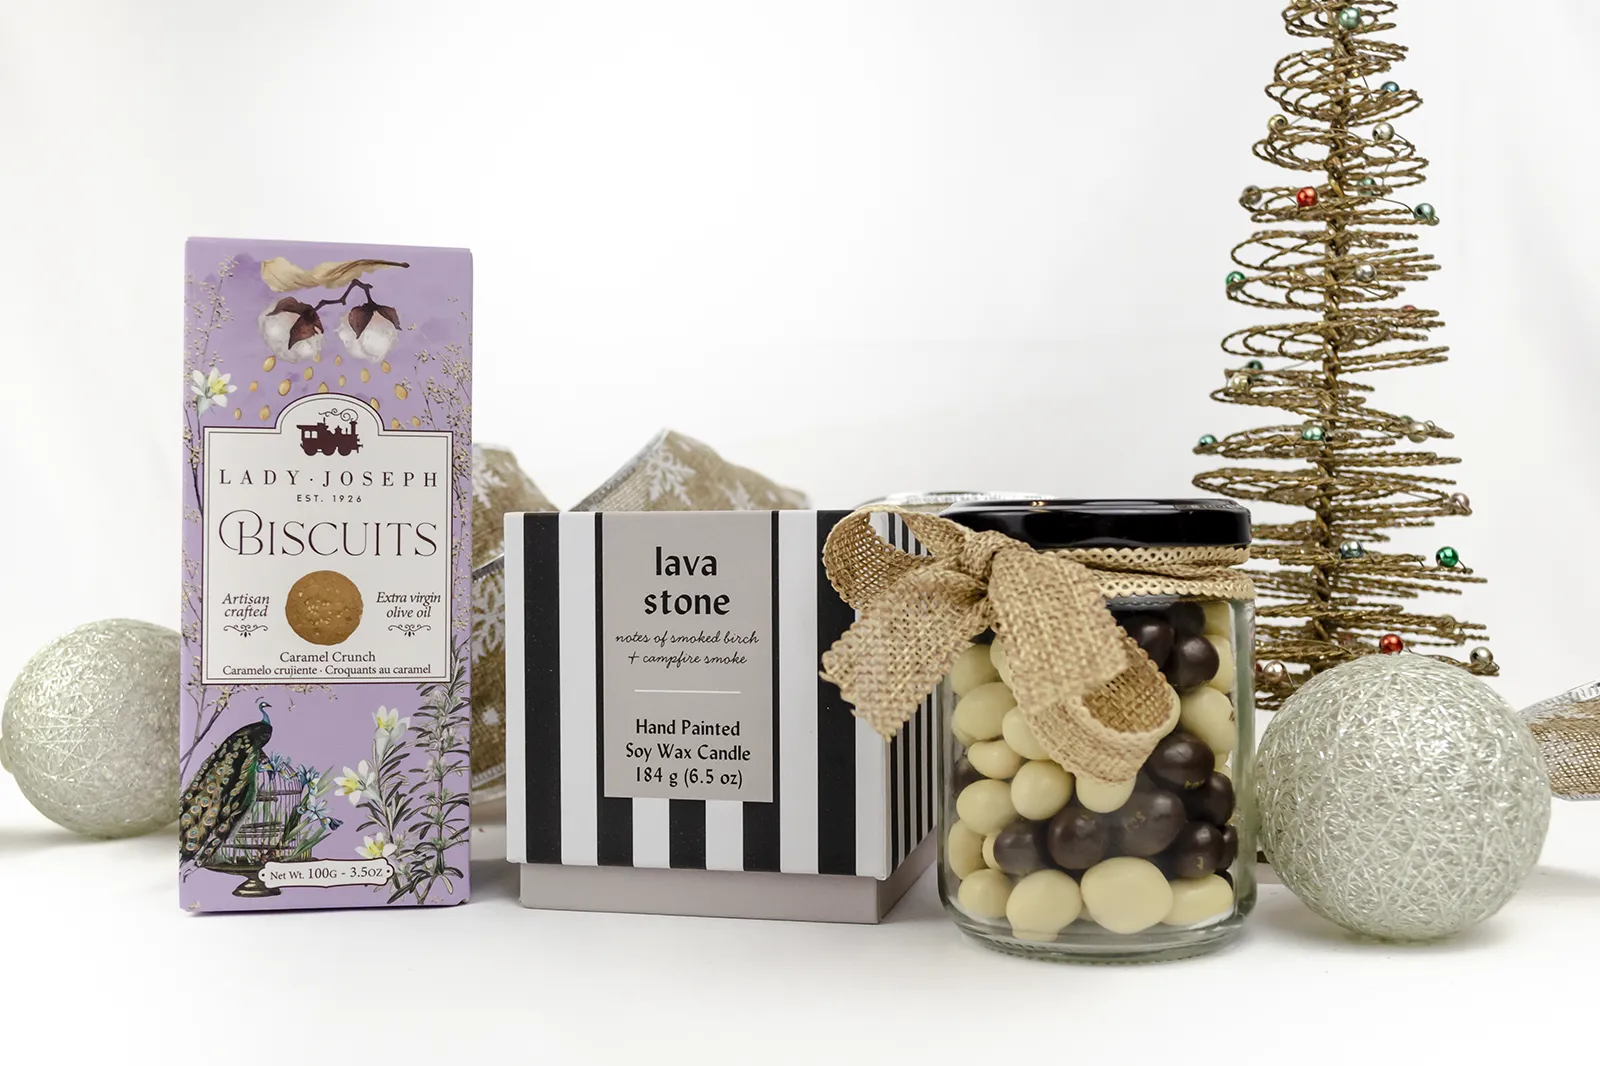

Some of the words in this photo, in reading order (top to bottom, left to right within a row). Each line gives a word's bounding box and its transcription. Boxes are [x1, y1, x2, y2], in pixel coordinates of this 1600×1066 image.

[219, 469, 300, 486] LADY
[322, 470, 438, 488] JOSEPH
[296, 494, 324, 503] EST.
[332, 494, 362, 503] 1926
[218, 509, 438, 557] BISCUITS
[655, 546, 718, 576] lava
[221, 592, 270, 605] Artisan
[375, 591, 408, 604] Extra
[410, 591, 442, 606] virgin
[643, 589, 731, 616] stone
[223, 605, 268, 621] crafted
[385, 605, 413, 619] olive
[416, 604, 432, 619] oil
[614, 631, 651, 645] notes
[653, 630, 669, 649] of
[670, 629, 721, 645] smoked
[723, 629, 760, 645] birch
[279, 651, 329, 663] Caramel
[331, 651, 376, 663] Crunch
[642, 649, 702, 669] campfire
[703, 650, 748, 665] smoke
[222, 664, 272, 676] Caramelo
[273, 665, 318, 678] crujiente
[324, 664, 377, 679] Croquants
[378, 667, 392, 675] au
[392, 664, 432, 676] caramel
[635, 718, 676, 735] Hand
[681, 719, 741, 737] Painted
[625, 742, 653, 763] Soy
[656, 743, 693, 760] Wax
[697, 744, 751, 762] Candle
[636, 766, 664, 783] 184
[668, 773, 678, 788] g
[683, 768, 715, 789] (6.5
[719, 769, 743, 790] oz)
[270, 871, 287, 881] Net
[288, 870, 305, 880] Wt.
